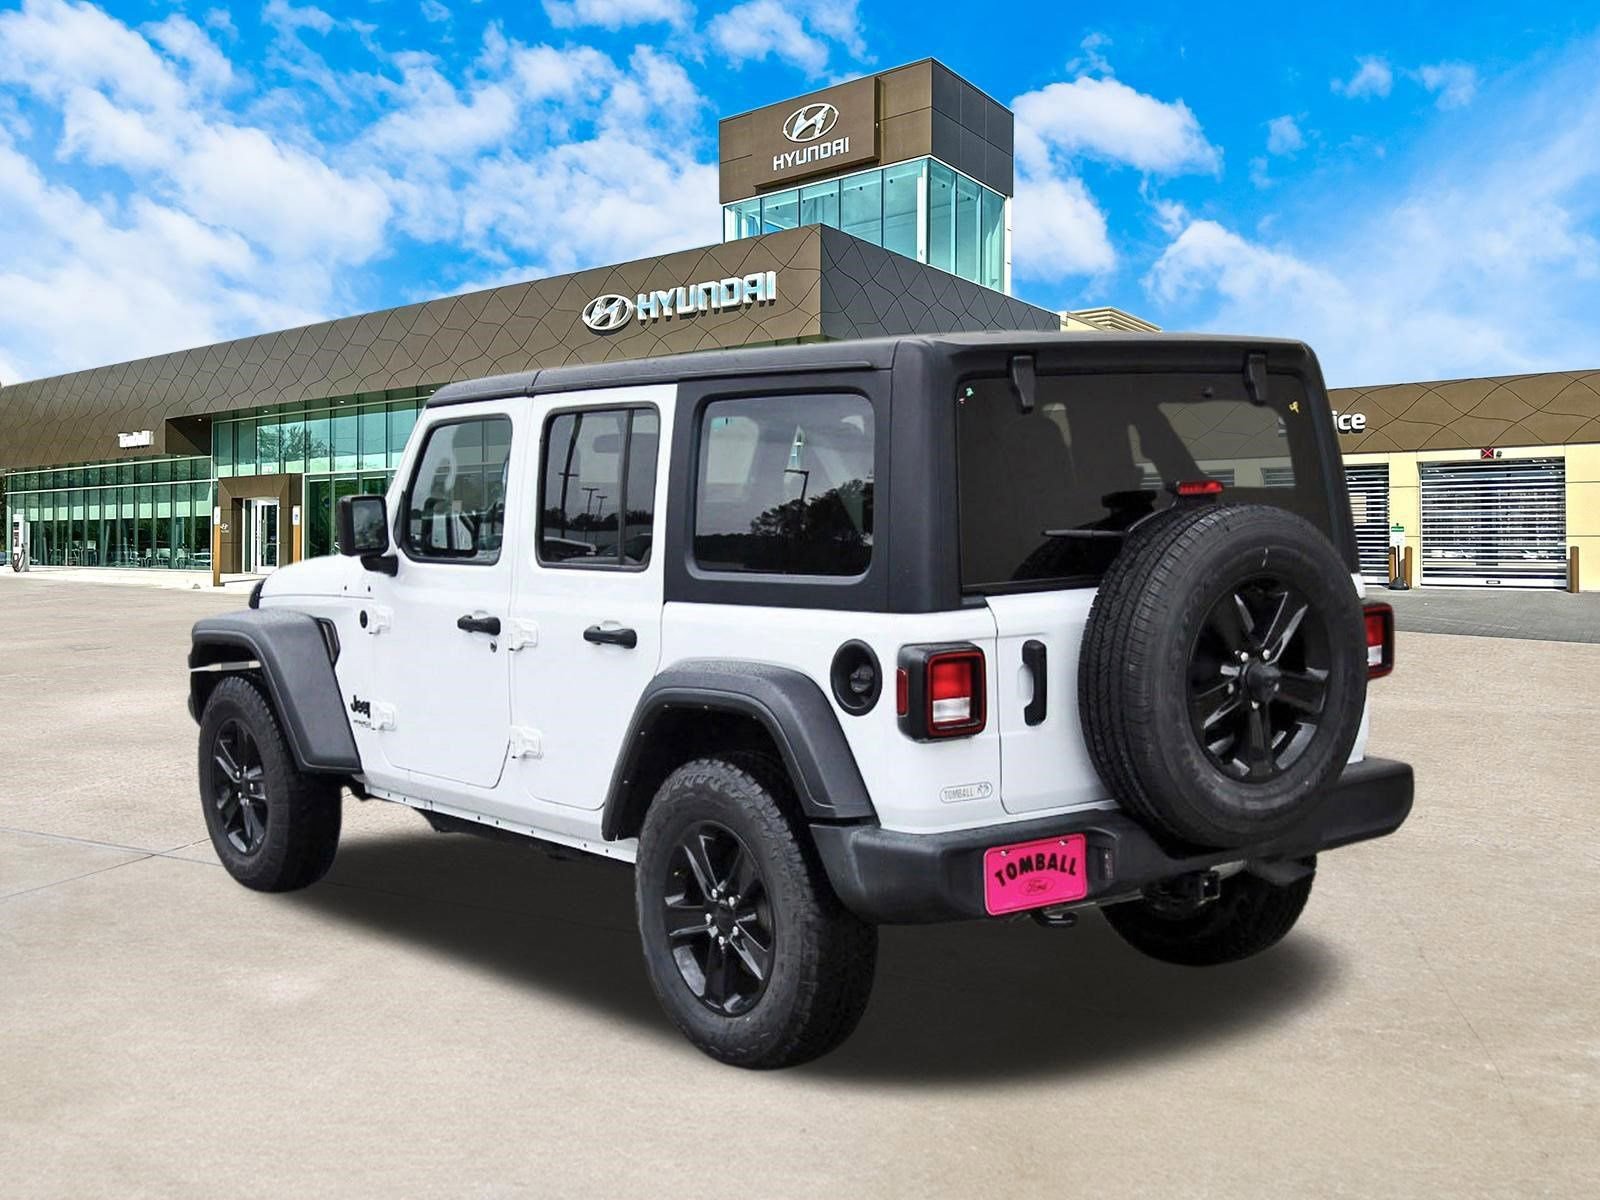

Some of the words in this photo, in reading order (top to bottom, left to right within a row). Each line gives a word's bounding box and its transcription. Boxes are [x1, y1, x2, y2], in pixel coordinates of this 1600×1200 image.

[773, 136, 849, 171] HYUNDAI
[636, 271, 776, 320] HYUNDAI
[350, 694, 371, 719] Jeep
[944, 786, 975, 801] TOMBALL
[995, 853, 1076, 887] TOMBALL
